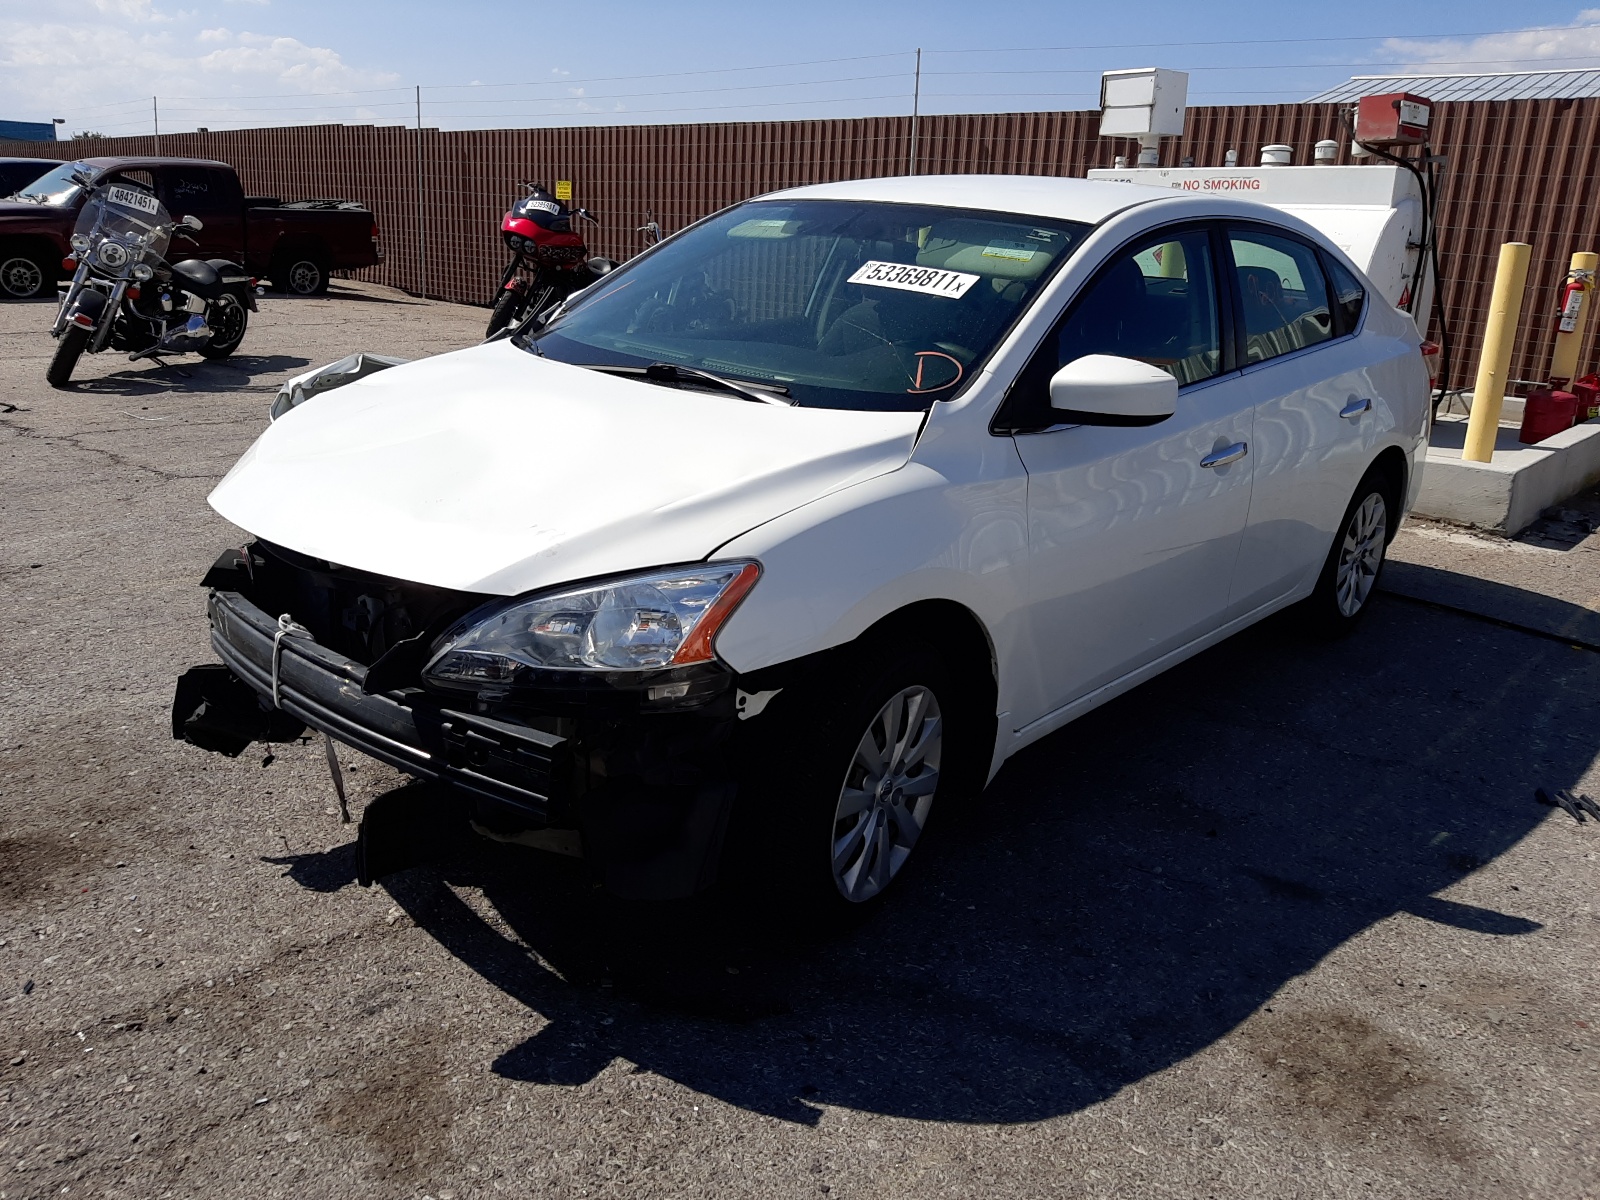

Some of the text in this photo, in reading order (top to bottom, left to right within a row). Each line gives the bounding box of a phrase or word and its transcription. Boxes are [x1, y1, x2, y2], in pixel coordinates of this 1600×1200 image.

[1183, 180, 1200, 190] NO
[1203, 179, 1260, 190] SMOKING
[907, 351, 962, 393] D
